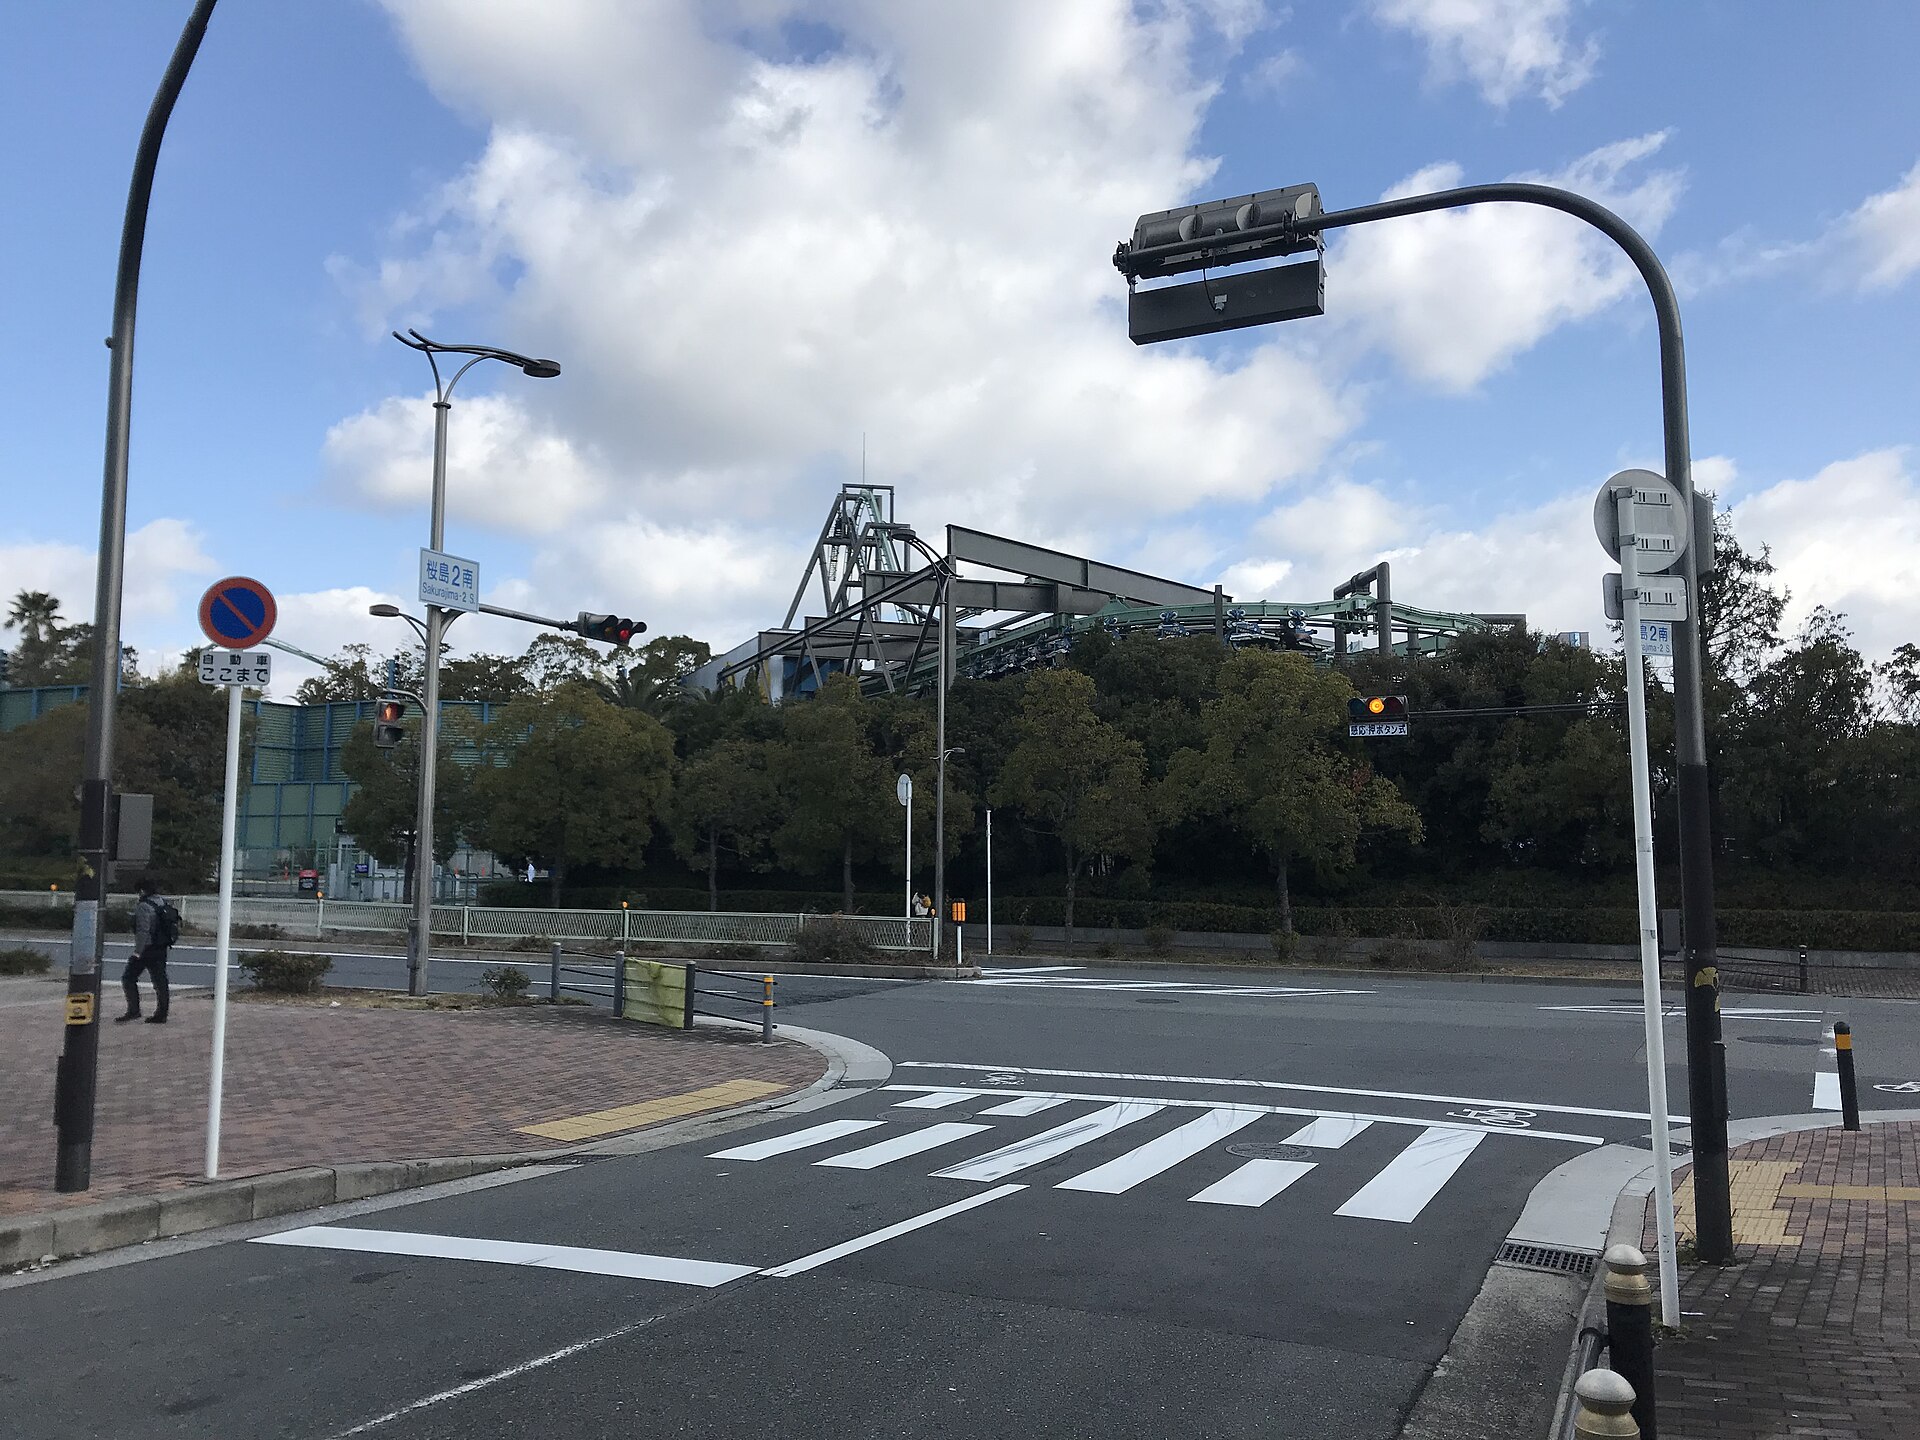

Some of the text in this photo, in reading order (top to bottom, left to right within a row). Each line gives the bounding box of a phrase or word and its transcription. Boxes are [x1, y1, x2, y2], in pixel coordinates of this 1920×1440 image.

[427, 559, 473, 590] 桜島2南
[422, 582, 467, 602] Sakurajima-2
[1640, 625, 1668, 642] 島2南
[1641, 643, 1664, 653] ajima-2
[203, 654, 268, 666] 自動車
[202, 667, 268, 683] ここまで
